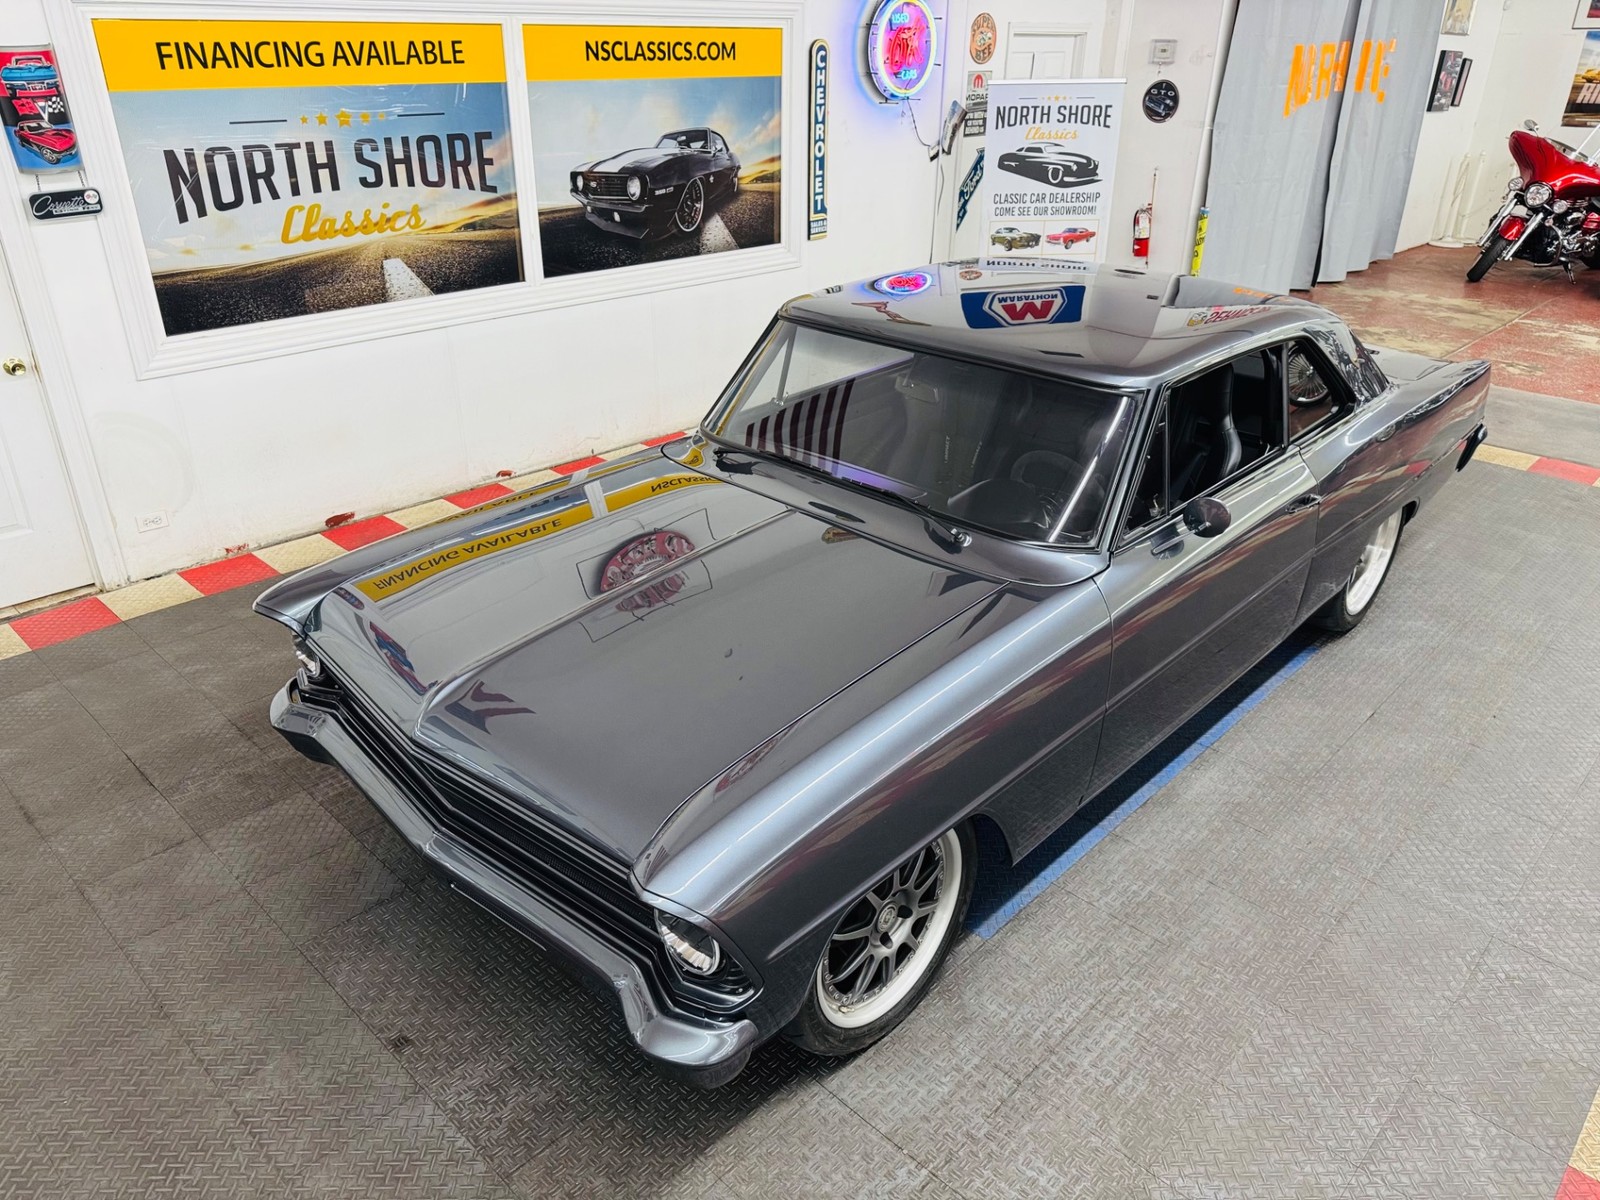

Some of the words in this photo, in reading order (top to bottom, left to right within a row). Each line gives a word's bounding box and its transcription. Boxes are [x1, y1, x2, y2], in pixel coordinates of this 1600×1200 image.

[155, 40, 325, 70] FINANCING
[332, 40, 466, 67] AVAILABLE
[585, 40, 736, 61] NSCLASSICS.COM
[975, 43, 992, 61] BEE
[1150, 88, 1175, 96] GTO
[995, 105, 1051, 130] NORTH
[1057, 105, 1113, 129] SHORE
[814, 50, 826, 211] CHEVROLET
[1024, 126, 1079, 141] Classics
[163, 139, 341, 225] NORTH
[353, 130, 498, 194] SHORE
[33, 195, 88, 216] Corvette
[993, 193, 1028, 205] CLASSIC
[1030, 192, 1047, 204] CAR
[1048, 192, 1101, 204] DEALERSHIP
[994, 206, 1016, 217] COME
[1017, 206, 1031, 216] SEE
[1033, 206, 1049, 216] OUR
[1050, 205, 1097, 216] SHOWROOM!
[280, 201, 427, 245] Classics
